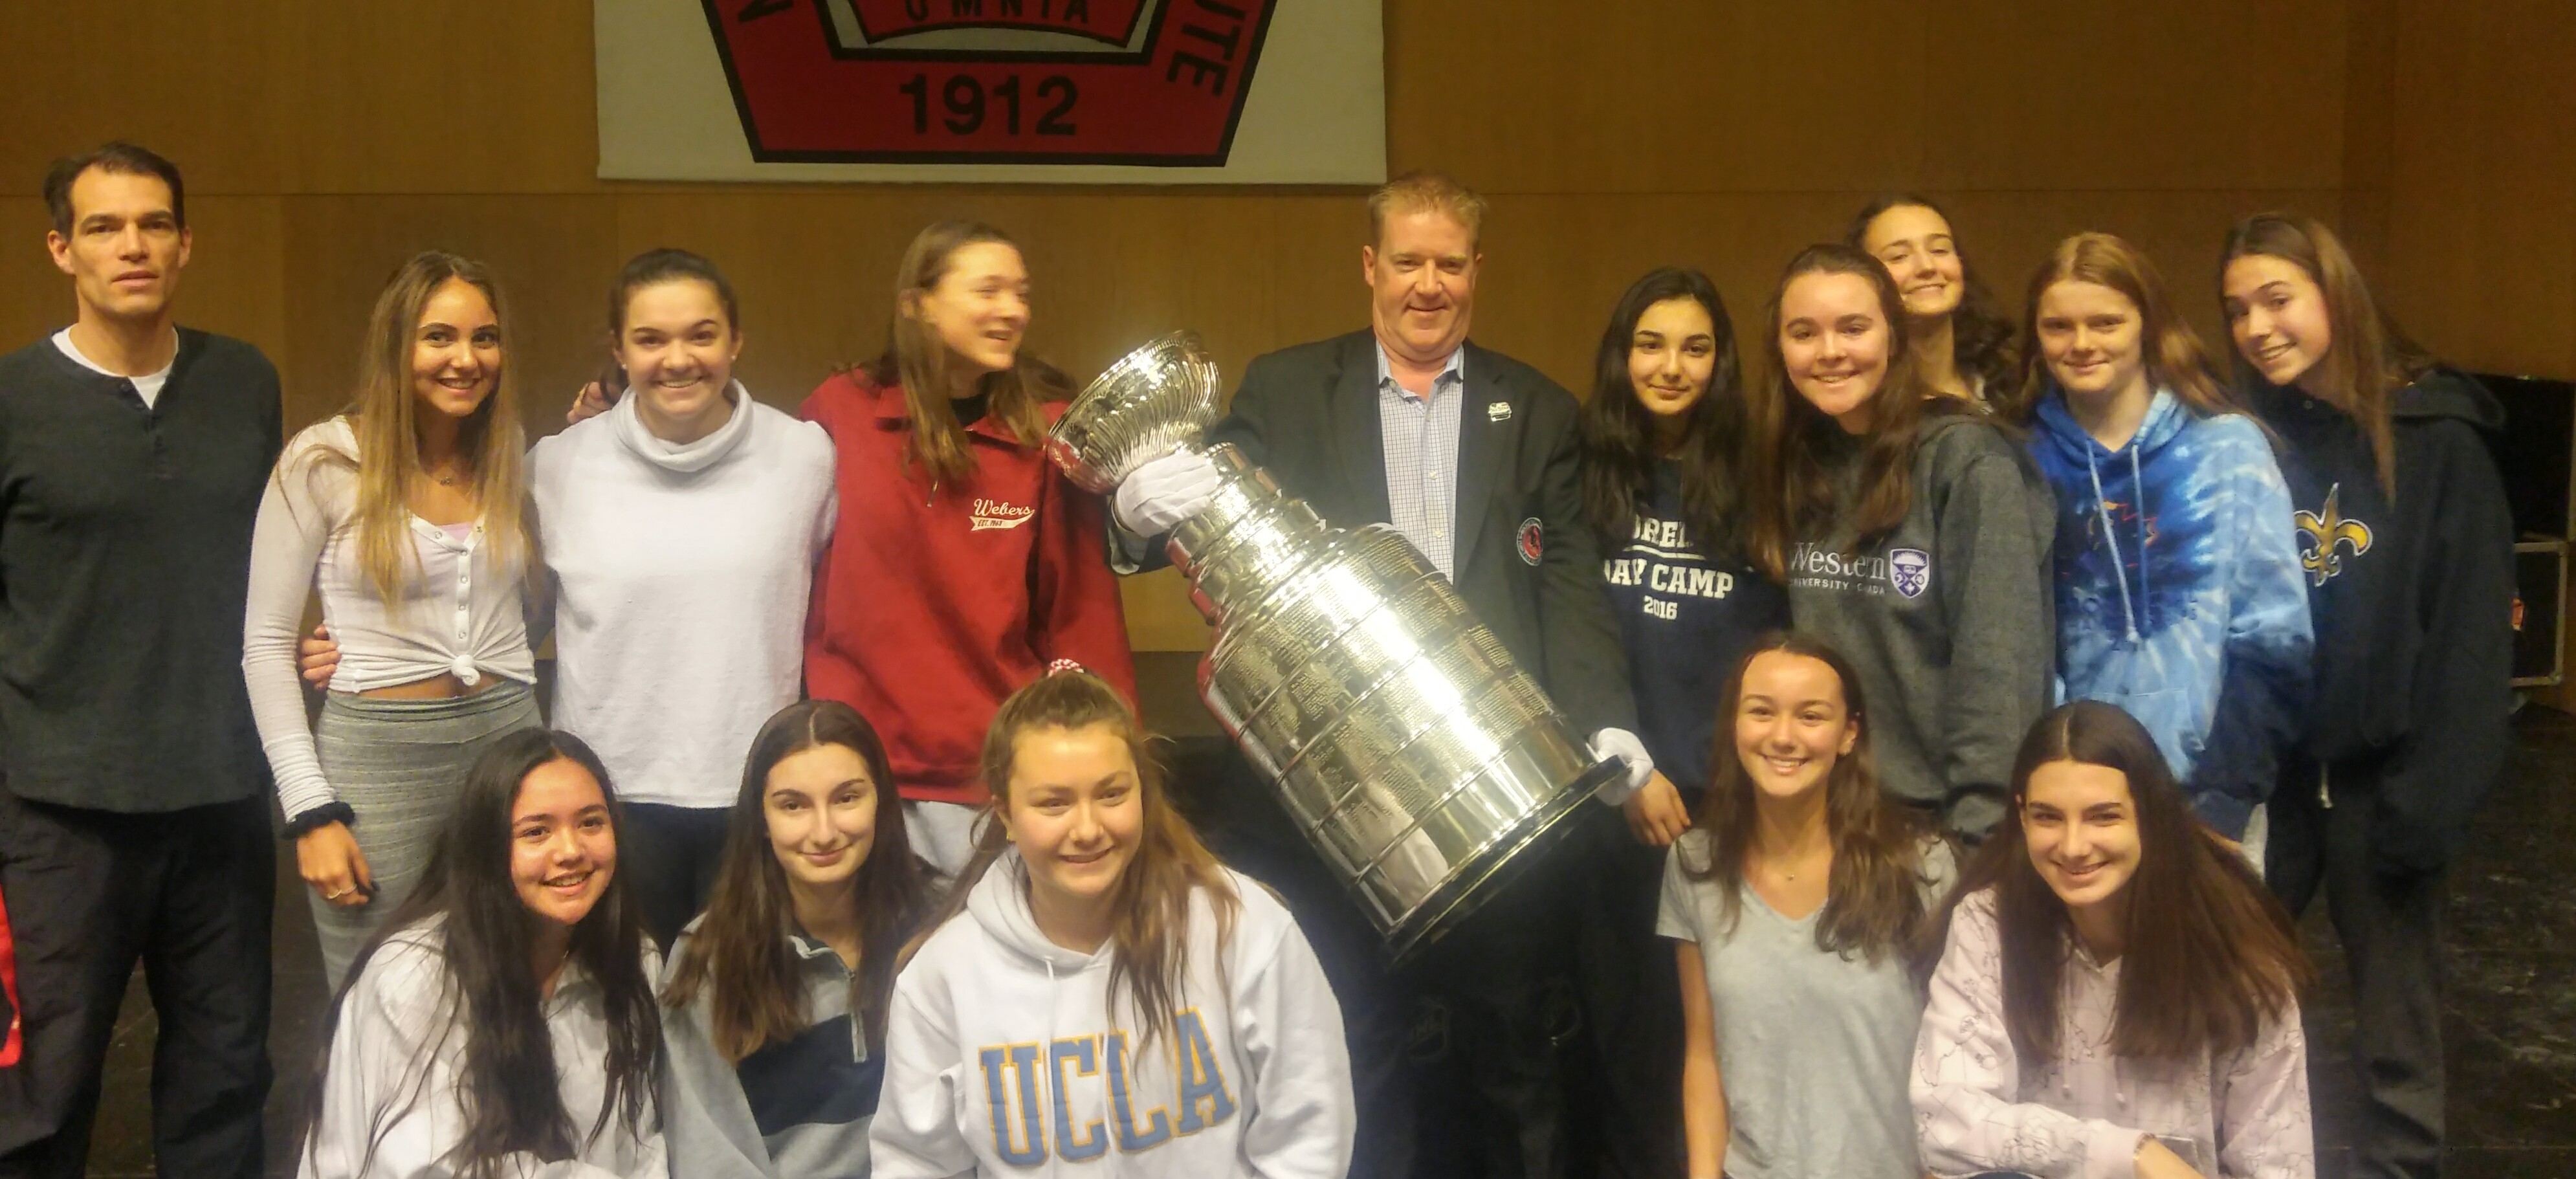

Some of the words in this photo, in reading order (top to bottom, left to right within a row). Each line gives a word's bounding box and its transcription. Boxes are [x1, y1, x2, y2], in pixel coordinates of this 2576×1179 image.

[899, 73, 1079, 135] 1912
[974, 498, 1030, 516] Webers
[1651, 563, 1735, 600] CAMP
[1643, 595, 1678, 620] 2016
[978, 1005, 1238, 1168] UCLA
